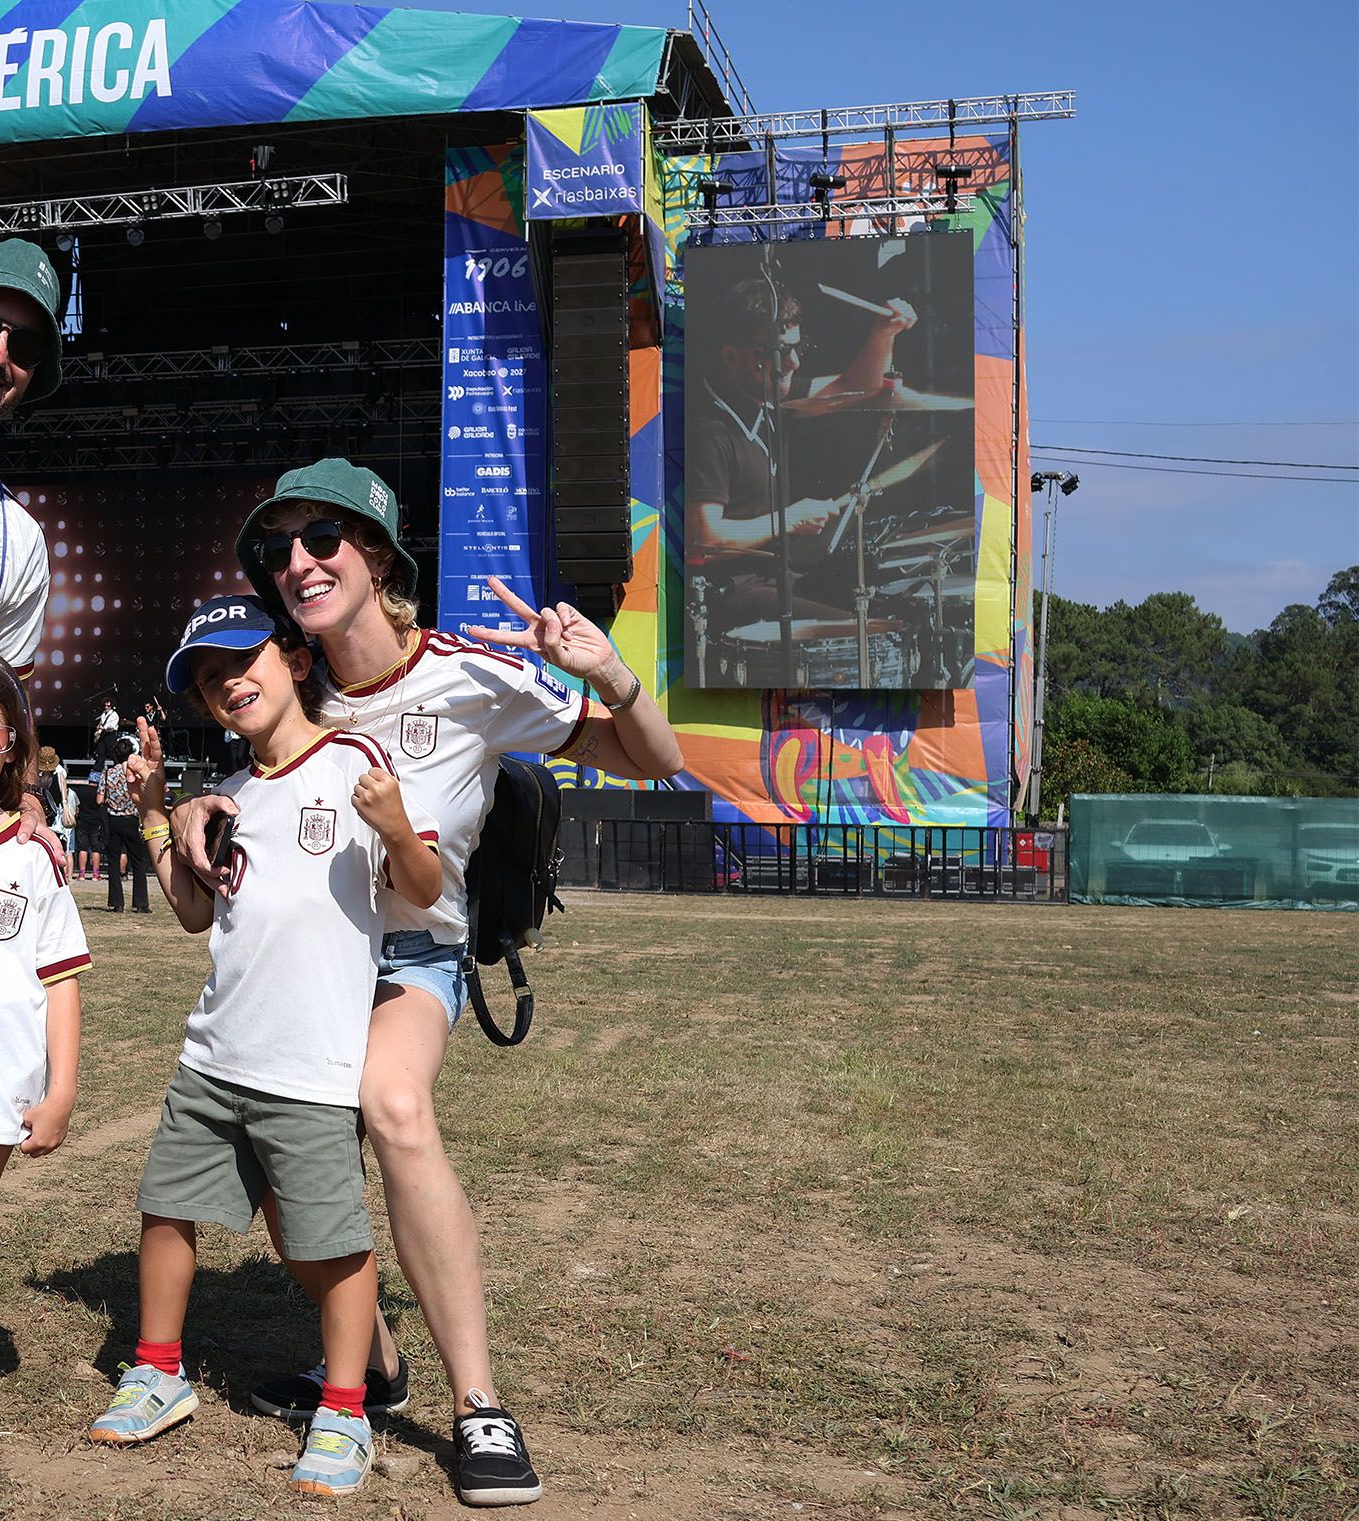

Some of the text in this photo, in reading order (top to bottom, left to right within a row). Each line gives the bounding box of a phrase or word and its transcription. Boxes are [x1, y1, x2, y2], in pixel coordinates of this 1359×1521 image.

[543, 164, 625, 180] ESCENARIO
[465, 254, 529, 282] 1906
[515, 300, 537, 312] live
[476, 466, 510, 476] GADIS
